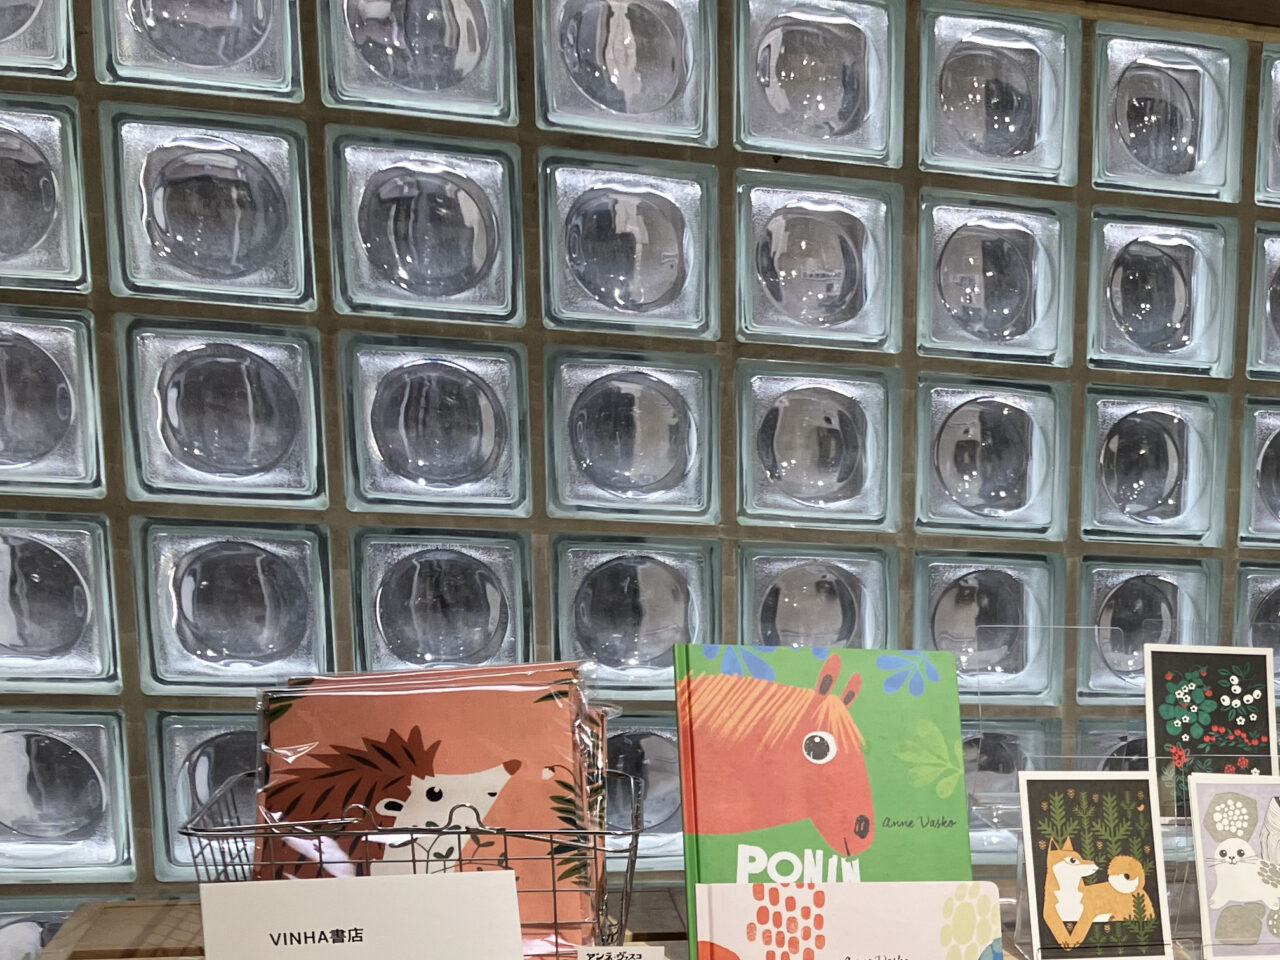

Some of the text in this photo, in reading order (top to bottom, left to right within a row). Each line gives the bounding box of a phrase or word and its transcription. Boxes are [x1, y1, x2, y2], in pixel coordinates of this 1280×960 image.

[882, 816, 957, 829] Anne Vasko
[736, 844, 861, 883] PONIN
[269, 927, 365, 947] VINHA書店
